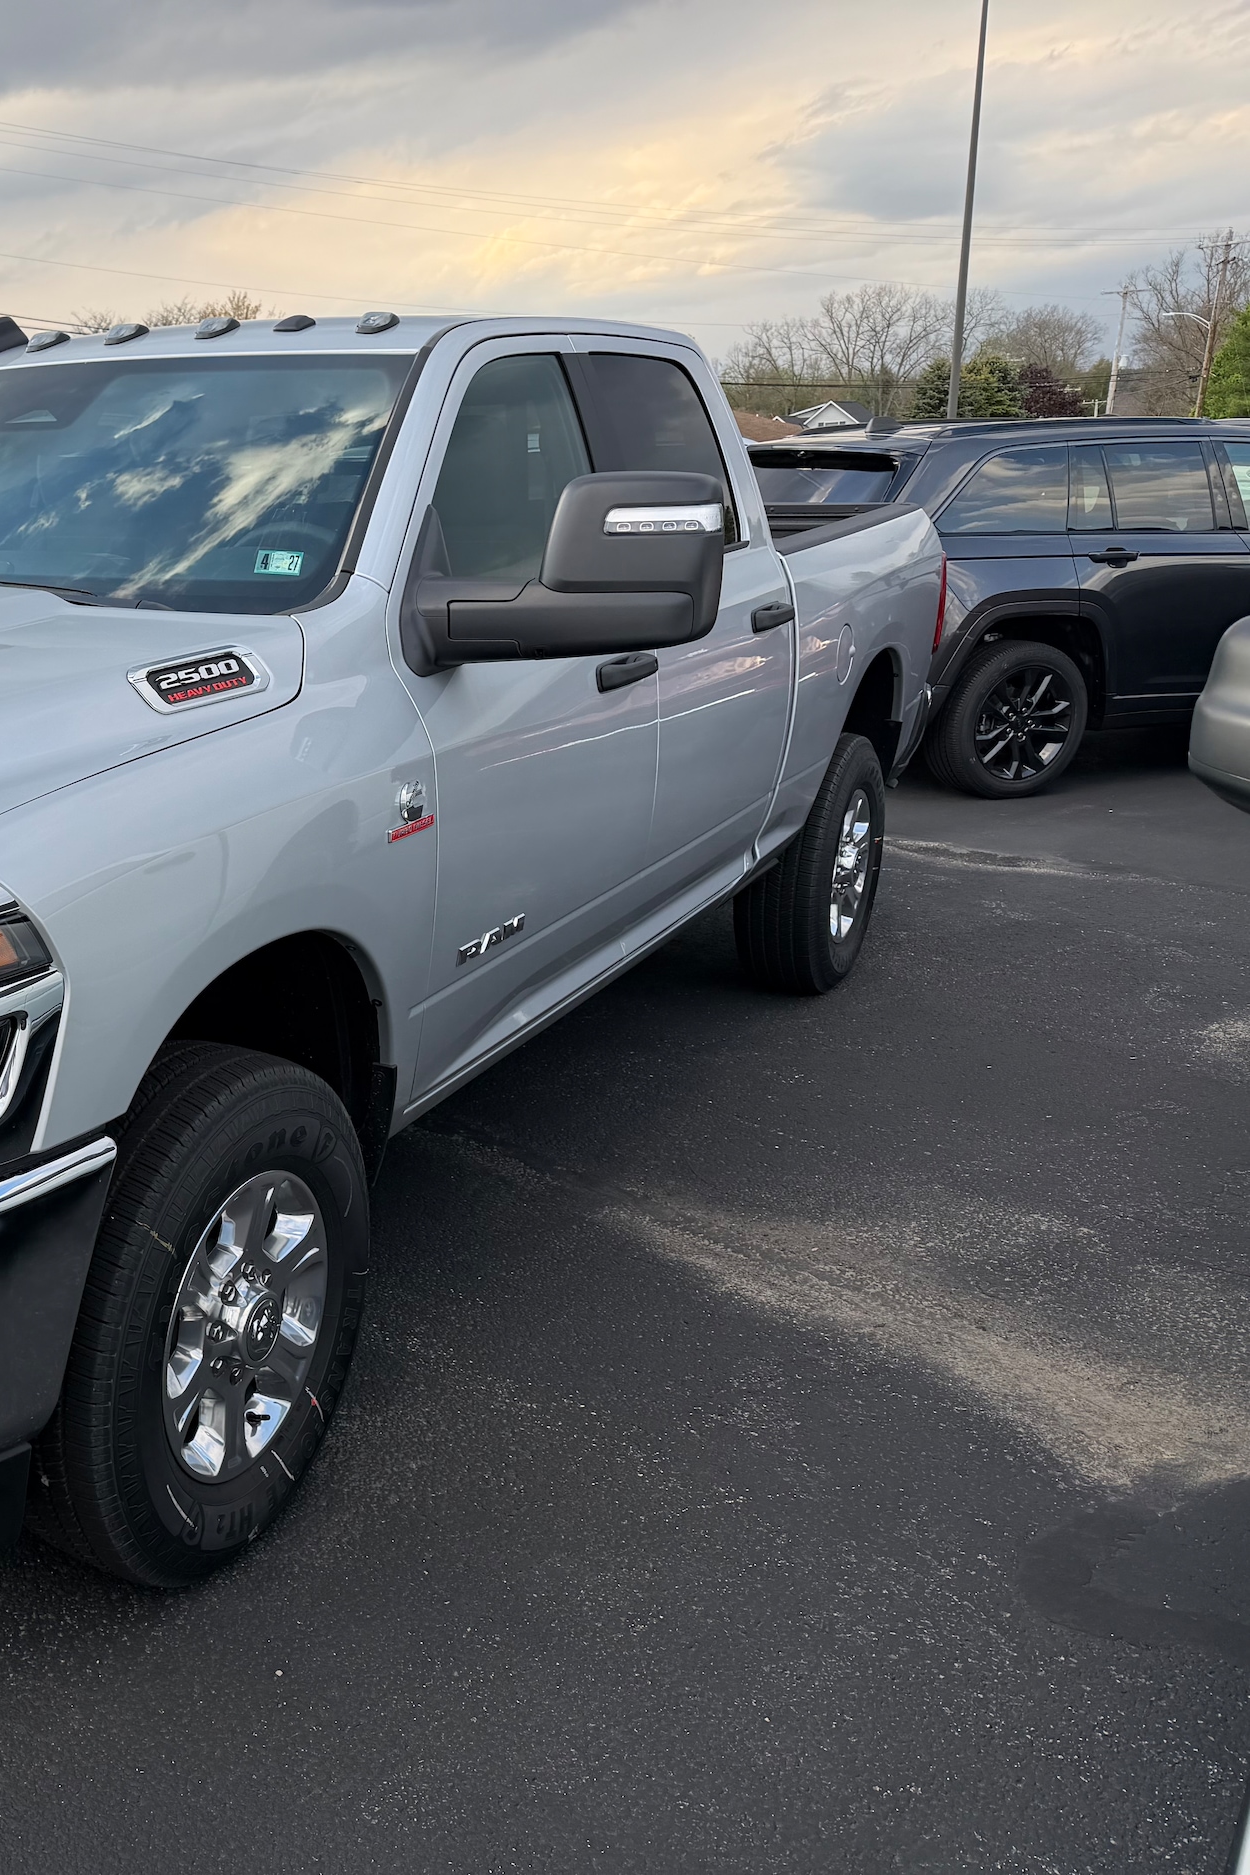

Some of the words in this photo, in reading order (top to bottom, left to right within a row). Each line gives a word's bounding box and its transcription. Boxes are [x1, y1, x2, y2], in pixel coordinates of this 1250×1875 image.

[260, 553, 270, 570] 4
[287, 555, 300, 571] 27
[155, 658, 240, 690] 2500
[168, 684, 211, 702] HEAVY
[213, 676, 248, 691] DUTY
[455, 912, 526, 967] RAM
